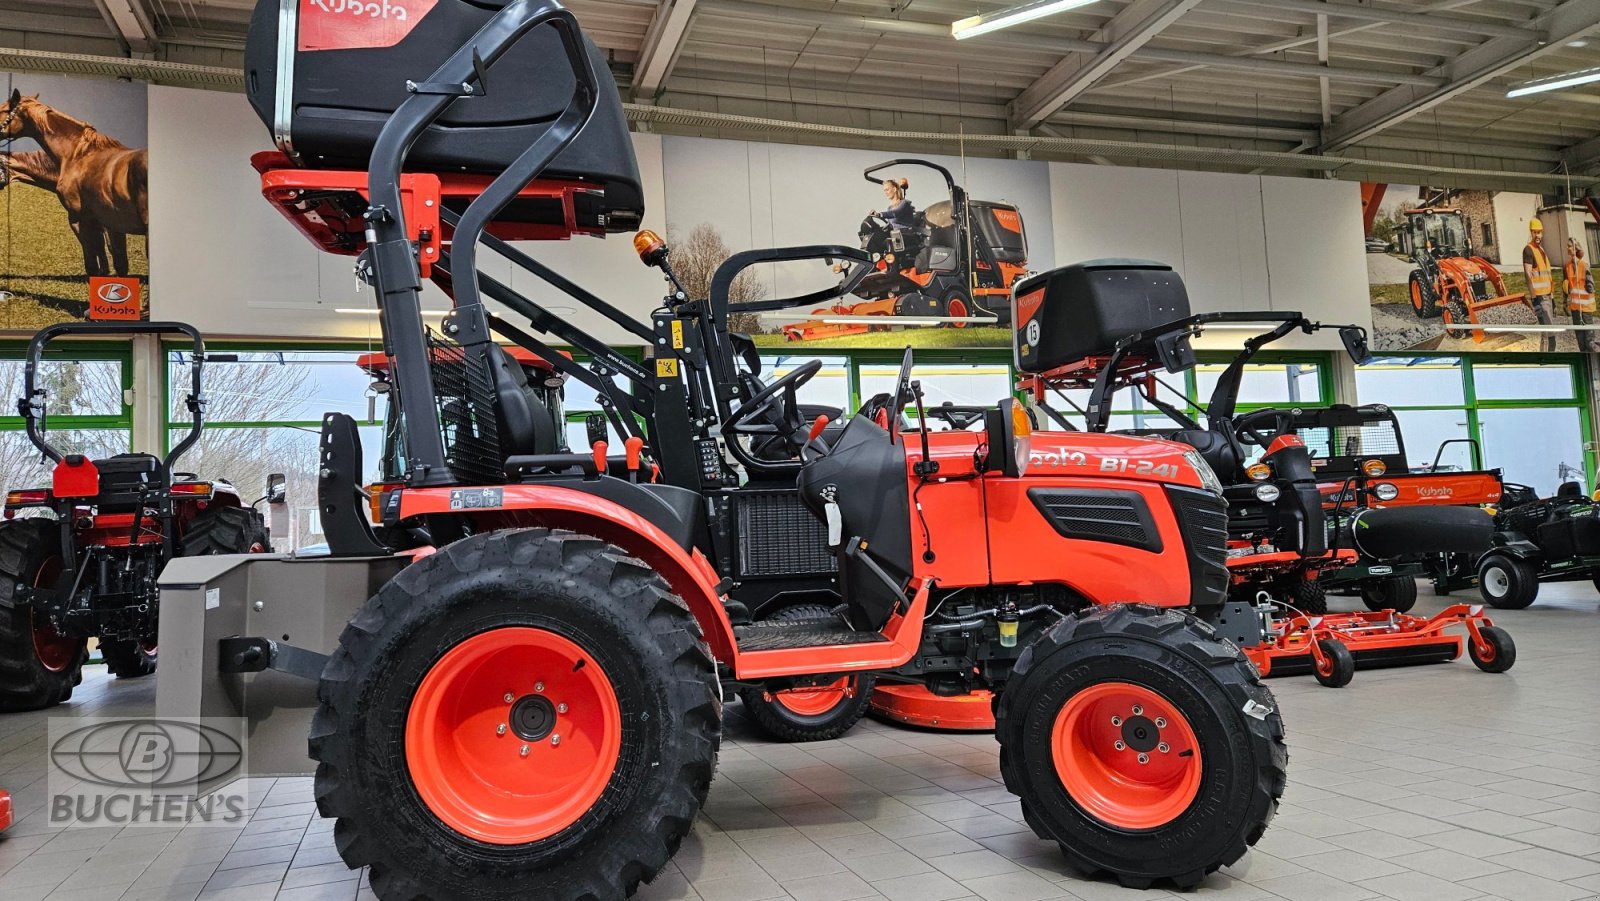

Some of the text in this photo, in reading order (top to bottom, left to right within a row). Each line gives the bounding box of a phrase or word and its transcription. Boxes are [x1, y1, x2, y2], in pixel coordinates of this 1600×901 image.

[95, 305, 136, 315] Kubota
[1029, 324, 1037, 342] 15
[1100, 457, 1178, 479] B1-241
[1416, 486, 1454, 497] Kubota
